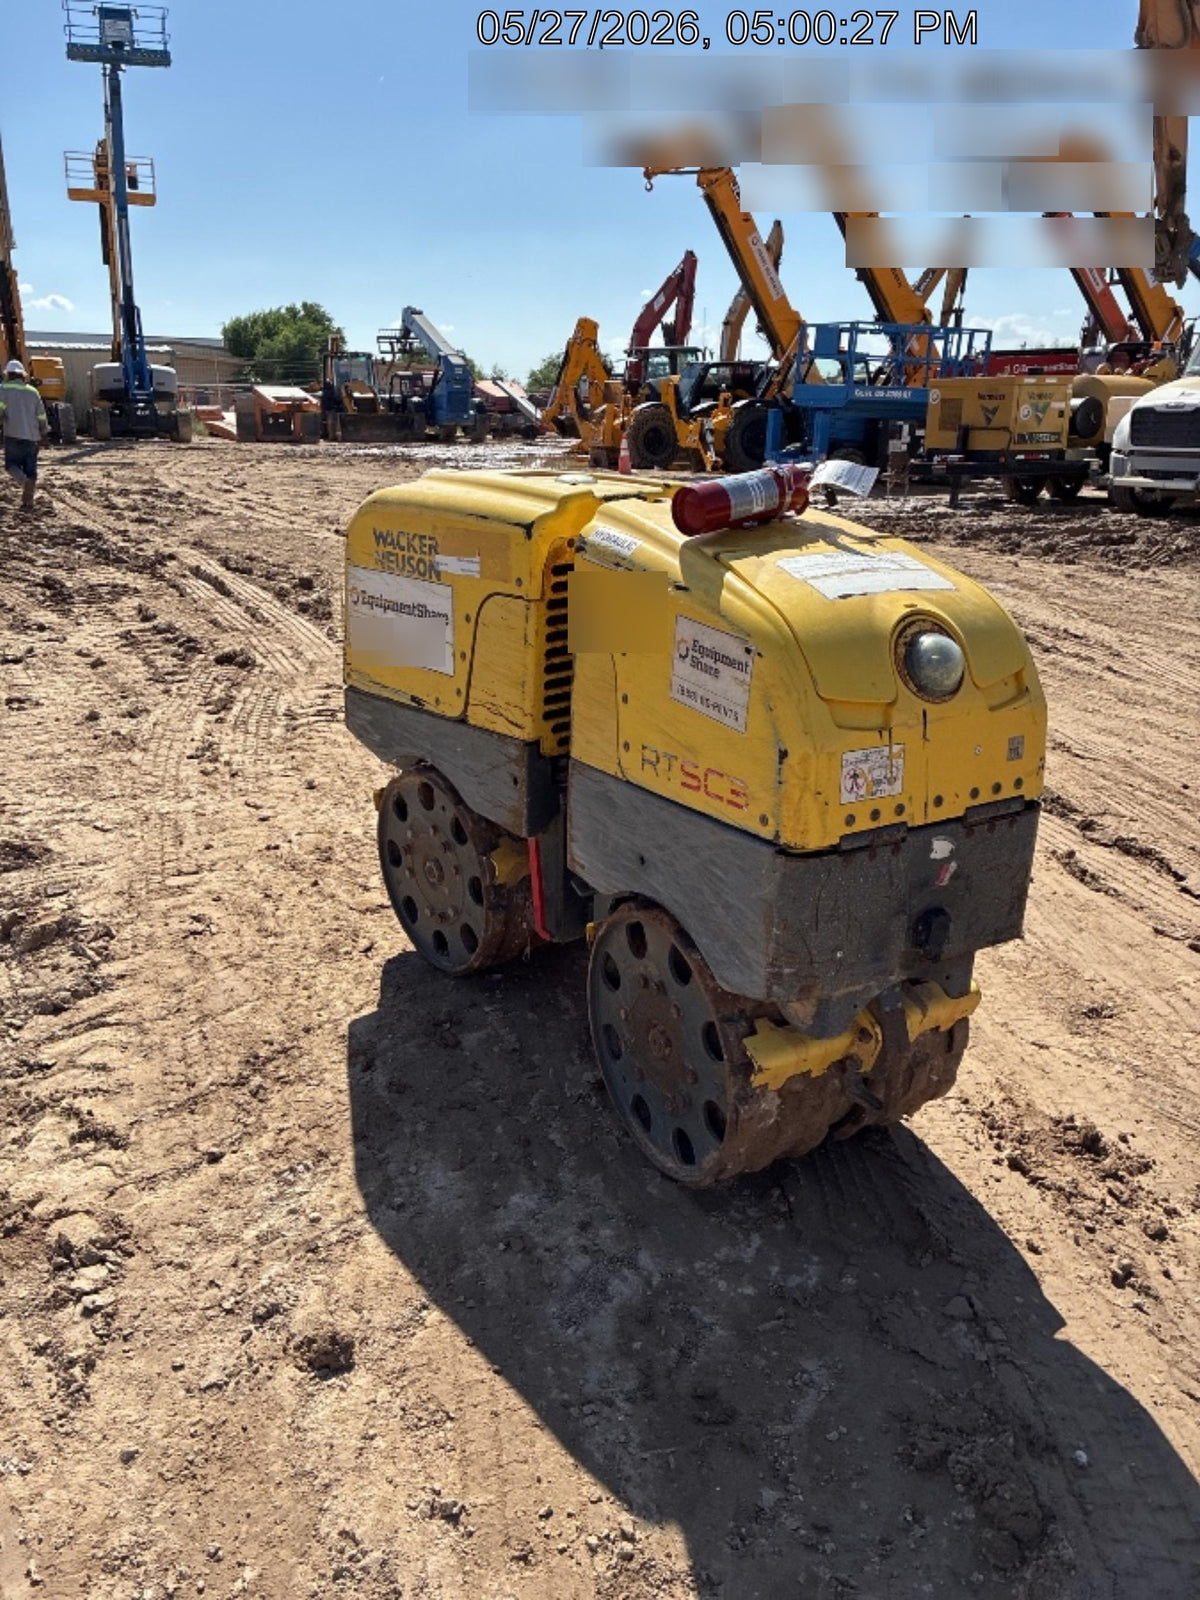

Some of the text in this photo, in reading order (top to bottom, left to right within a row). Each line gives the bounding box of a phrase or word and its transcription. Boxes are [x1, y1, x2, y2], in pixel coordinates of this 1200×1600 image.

[372, 527, 440, 556] WACKER
[374, 550, 442, 582] NEUSON
[691, 639, 749, 675] Equipment
